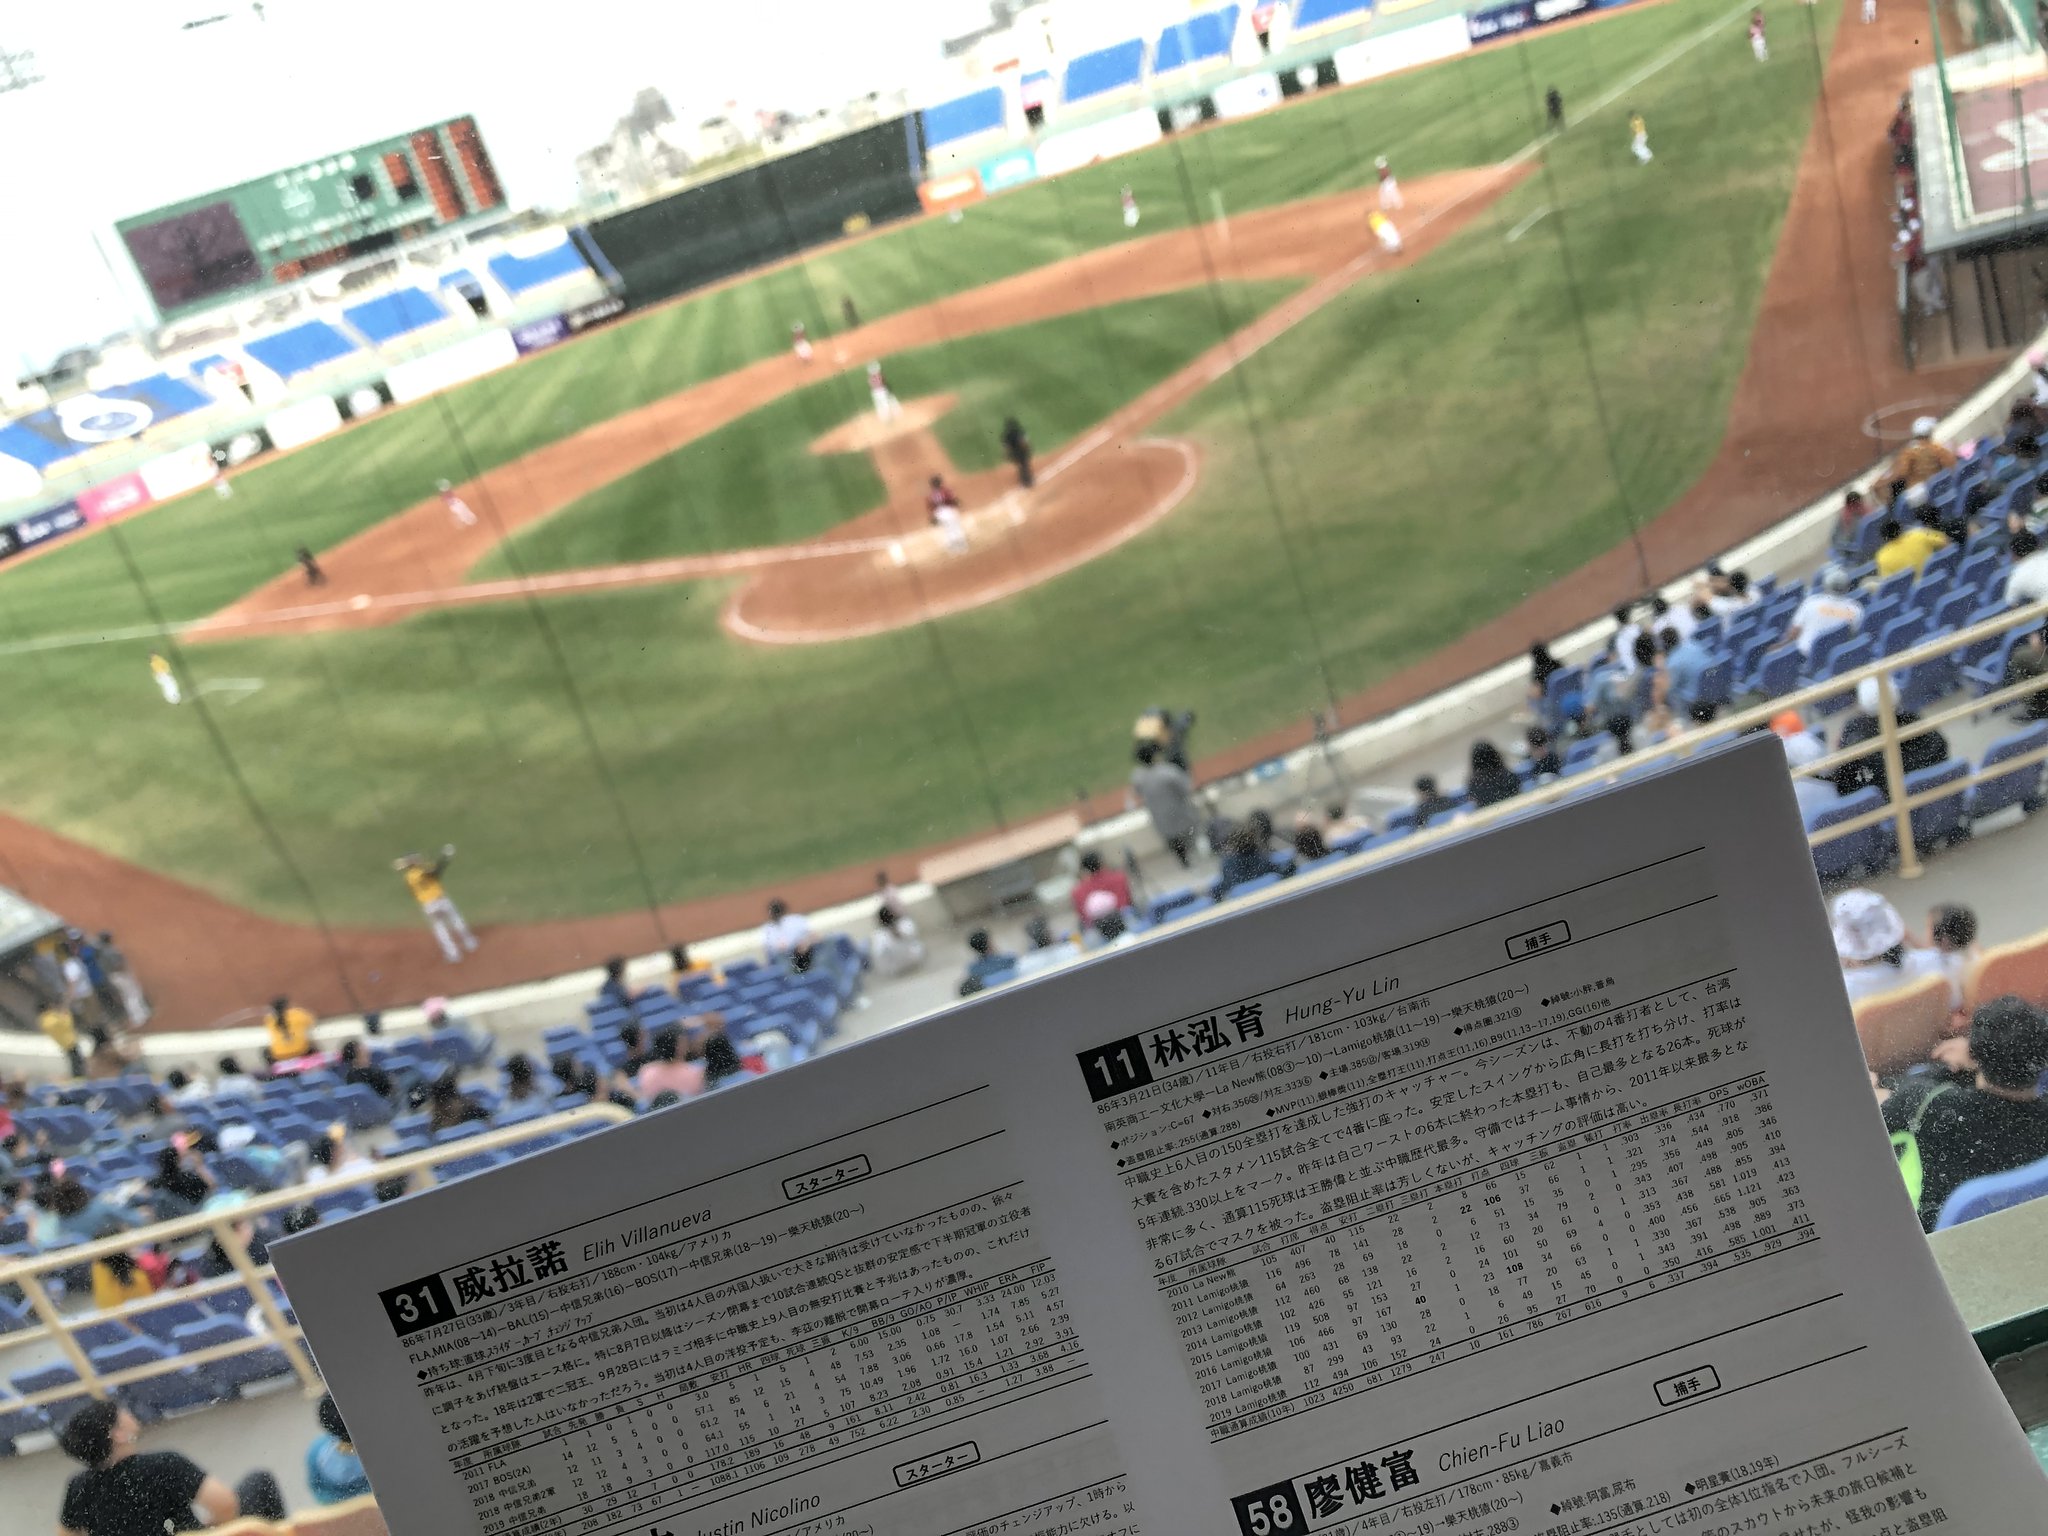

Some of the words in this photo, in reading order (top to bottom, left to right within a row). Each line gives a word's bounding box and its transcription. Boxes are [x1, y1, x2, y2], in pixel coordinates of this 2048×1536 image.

[1524, 931, 1551, 951] 捕手
[1091, 1047, 1137, 1089] 11
[1150, 1003, 1263, 1067] 林泓育
[1286, 987, 1365, 1024] Hung-Yu
[1373, 976, 1399, 996] Lin
[795, 1167, 859, 1194] スターター
[1171, 1297, 1193, 1311] 2011
[1265, 1267, 1282, 1279] 116
[1295, 1258, 1311, 1269] 496
[1328, 1248, 1341, 1258] 78
[1352, 1238, 1369, 1250] 141
[1392, 1226, 1404, 1237] 28
[1431, 1215, 1438, 1224] 2
[1459, 1204, 1472, 1214] 22
[1483, 1194, 1501, 1206] 106
[1518, 1183, 1529, 1195] 37
[1548, 1174, 1559, 1184] 66
[1580, 1165, 1586, 1174] 1
[1607, 1156, 1613, 1165] 1
[1625, 1146, 1643, 1159] .321
[1658, 1134, 1676, 1148] .374
[1691, 1123, 1709, 1136] .544
[1721, 1113, 1740, 1127] .918
[1754, 1102, 1773, 1115] .386
[1338, 1212, 1357, 1226] 安打
[1708, 1087, 1729, 1100] OPS
[1736, 1075, 1765, 1091] wOBA
[391, 1284, 440, 1325] 31
[453, 1241, 567, 1306] 威拉諾
[583, 1238, 615, 1261] Elih
[620, 1209, 711, 1247] Villanueva
[1194, 1365, 1217, 1380] 2016
[1289, 1335, 1305, 1347] 106
[1318, 1326, 1334, 1337] 466
[1351, 1315, 1362, 1327] 97
[1376, 1306, 1391, 1318] 167
[1415, 1295, 1426, 1304] 40
[1454, 1283, 1460, 1292] 1
[1482, 1271, 1495, 1282] 23
[1506, 1262, 1524, 1274] 108
[1541, 1252, 1552, 1262] 34
[1570, 1242, 1582, 1252] 66
[1602, 1233, 1609, 1242] 0
[1628, 1224, 1635, 1233] 0
[1647, 1214, 1665, 1227] .400
[1680, 1203, 1698, 1216] .456
[1713, 1191, 1731, 1205] .665
[1737, 1182, 1762, 1196] 1.121
[1776, 1170, 1795, 1184] .423
[636, 1398, 646, 1409] S
[656, 1391, 665, 1401] H
[737, 1361, 755, 1373] HR
[841, 1325, 861, 1340] K/9
[871, 1313, 896, 1329] BB/9
[900, 1301, 932, 1318] GO/AO
[936, 1292, 957, 1305] P/IP
[963, 1281, 991, 1296] WHIP
[998, 1272, 1018, 1287] ERA
[1030, 1262, 1049, 1277] FIP
[1673, 1376, 1701, 1397] 捕手
[472, 1493, 495, 1507] 2018
[566, 1464, 579, 1474] 12
[591, 1456, 602, 1466] 11
[615, 1449, 623, 1457] 3
[637, 1442, 643, 1450] 4
[656, 1435, 663, 1444] 0
[676, 1428, 683, 1437] 0
[699, 1416, 719, 1429] 61.2
[733, 1407, 745, 1418] 74
[763, 1399, 770, 1408] 6
[784, 1391, 796, 1401] 21
[814, 1382, 820, 1390] 4
[834, 1373, 846, 1384] 54
[859, 1363, 879, 1375] 7.88
[891, 1351, 911, 1364] 3.06
[925, 1340, 945, 1353] 0.66
[954, 1330, 973, 1343] 17.8
[986, 1320, 1004, 1333] 1.54
[1015, 1310, 1034, 1323] 5.11
[1046, 1299, 1064, 1312] 4.57
[751, 1495, 820, 1528] Nicolino
[906, 1454, 972, 1483] スターター
[1243, 1492, 1298, 1536] 58
[1304, 1450, 1419, 1518] 廖健富
[1439, 1431, 1520, 1471] Chien-Fu
[1527, 1419, 1564, 1442] Liao
